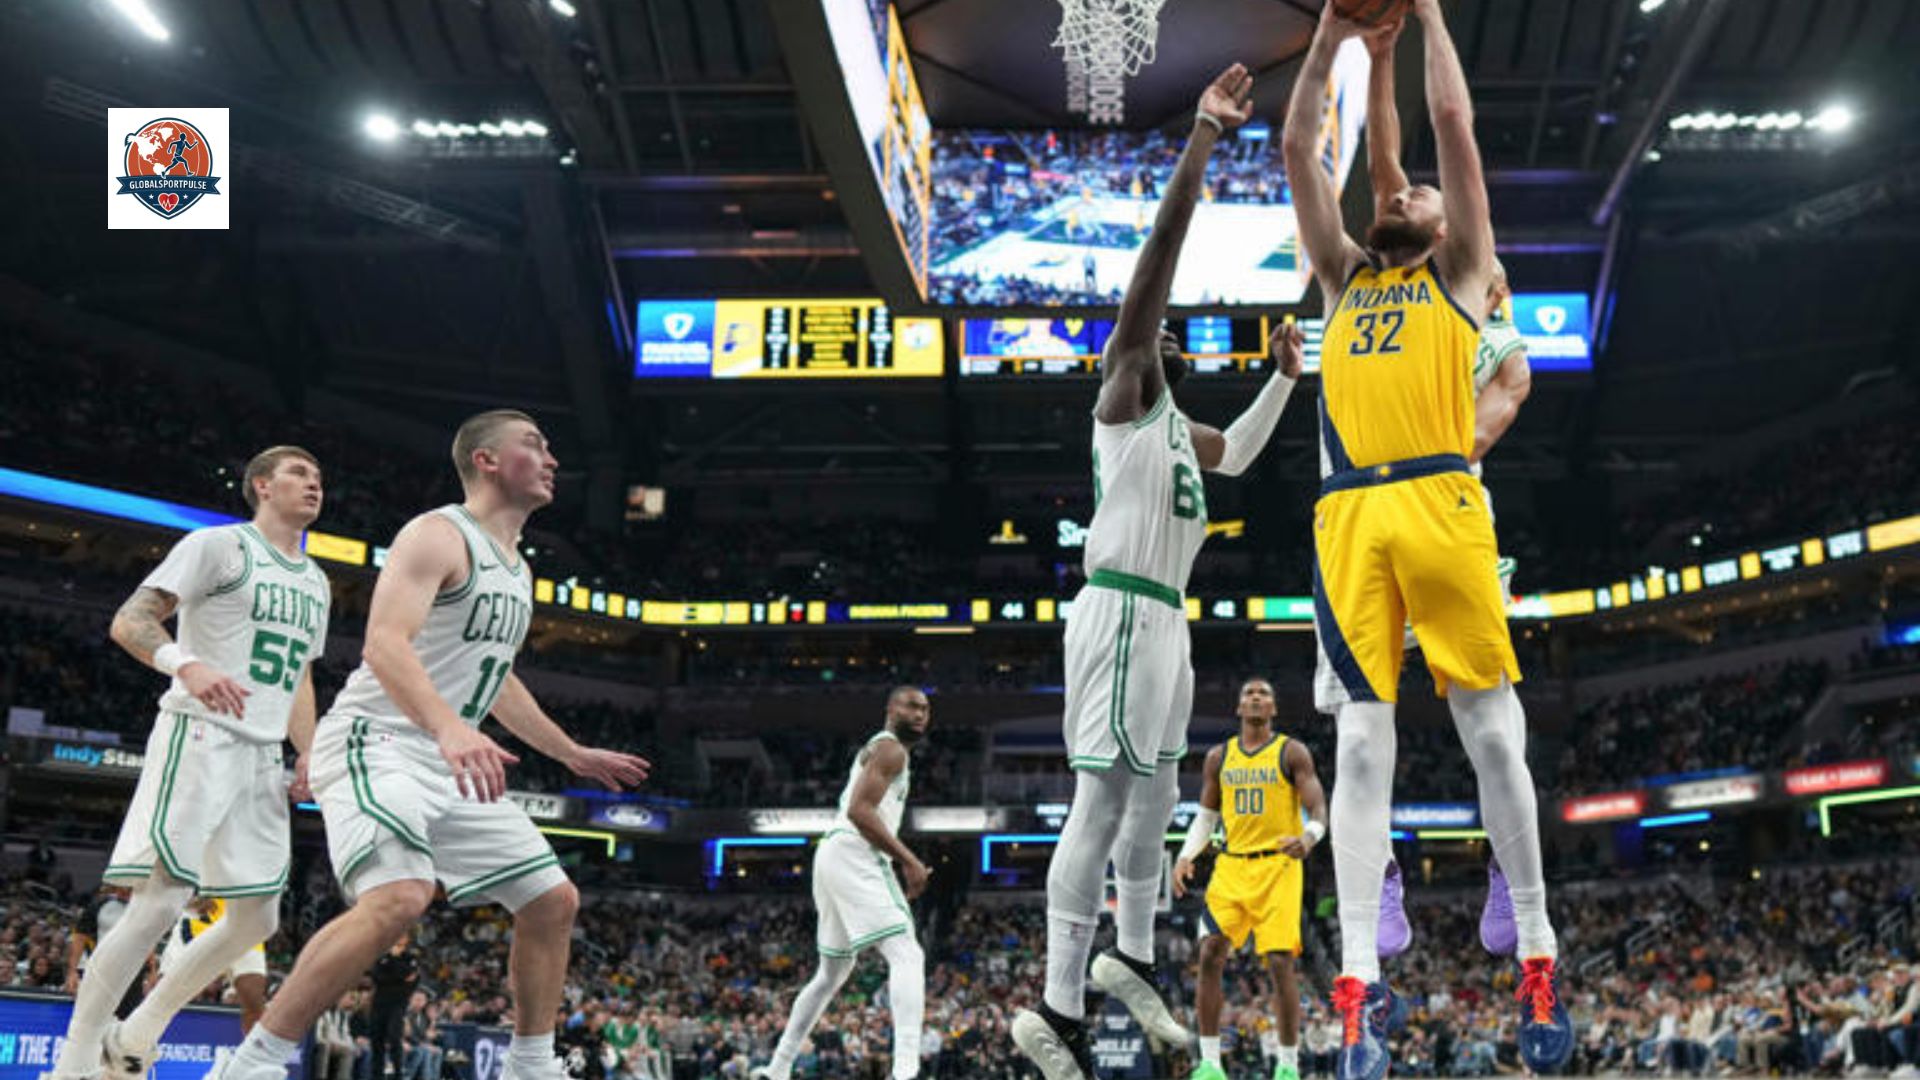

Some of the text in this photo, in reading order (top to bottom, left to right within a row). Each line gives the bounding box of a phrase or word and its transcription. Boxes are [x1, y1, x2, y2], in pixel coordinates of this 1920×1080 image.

[1350, 309, 1404, 355] 32
[249, 629, 308, 693] 55
[460, 655, 510, 719] 11
[1235, 788, 1263, 815] 00
[17, 1036, 51, 1064] THE
[159, 1043, 214, 1062] FANDUEL
